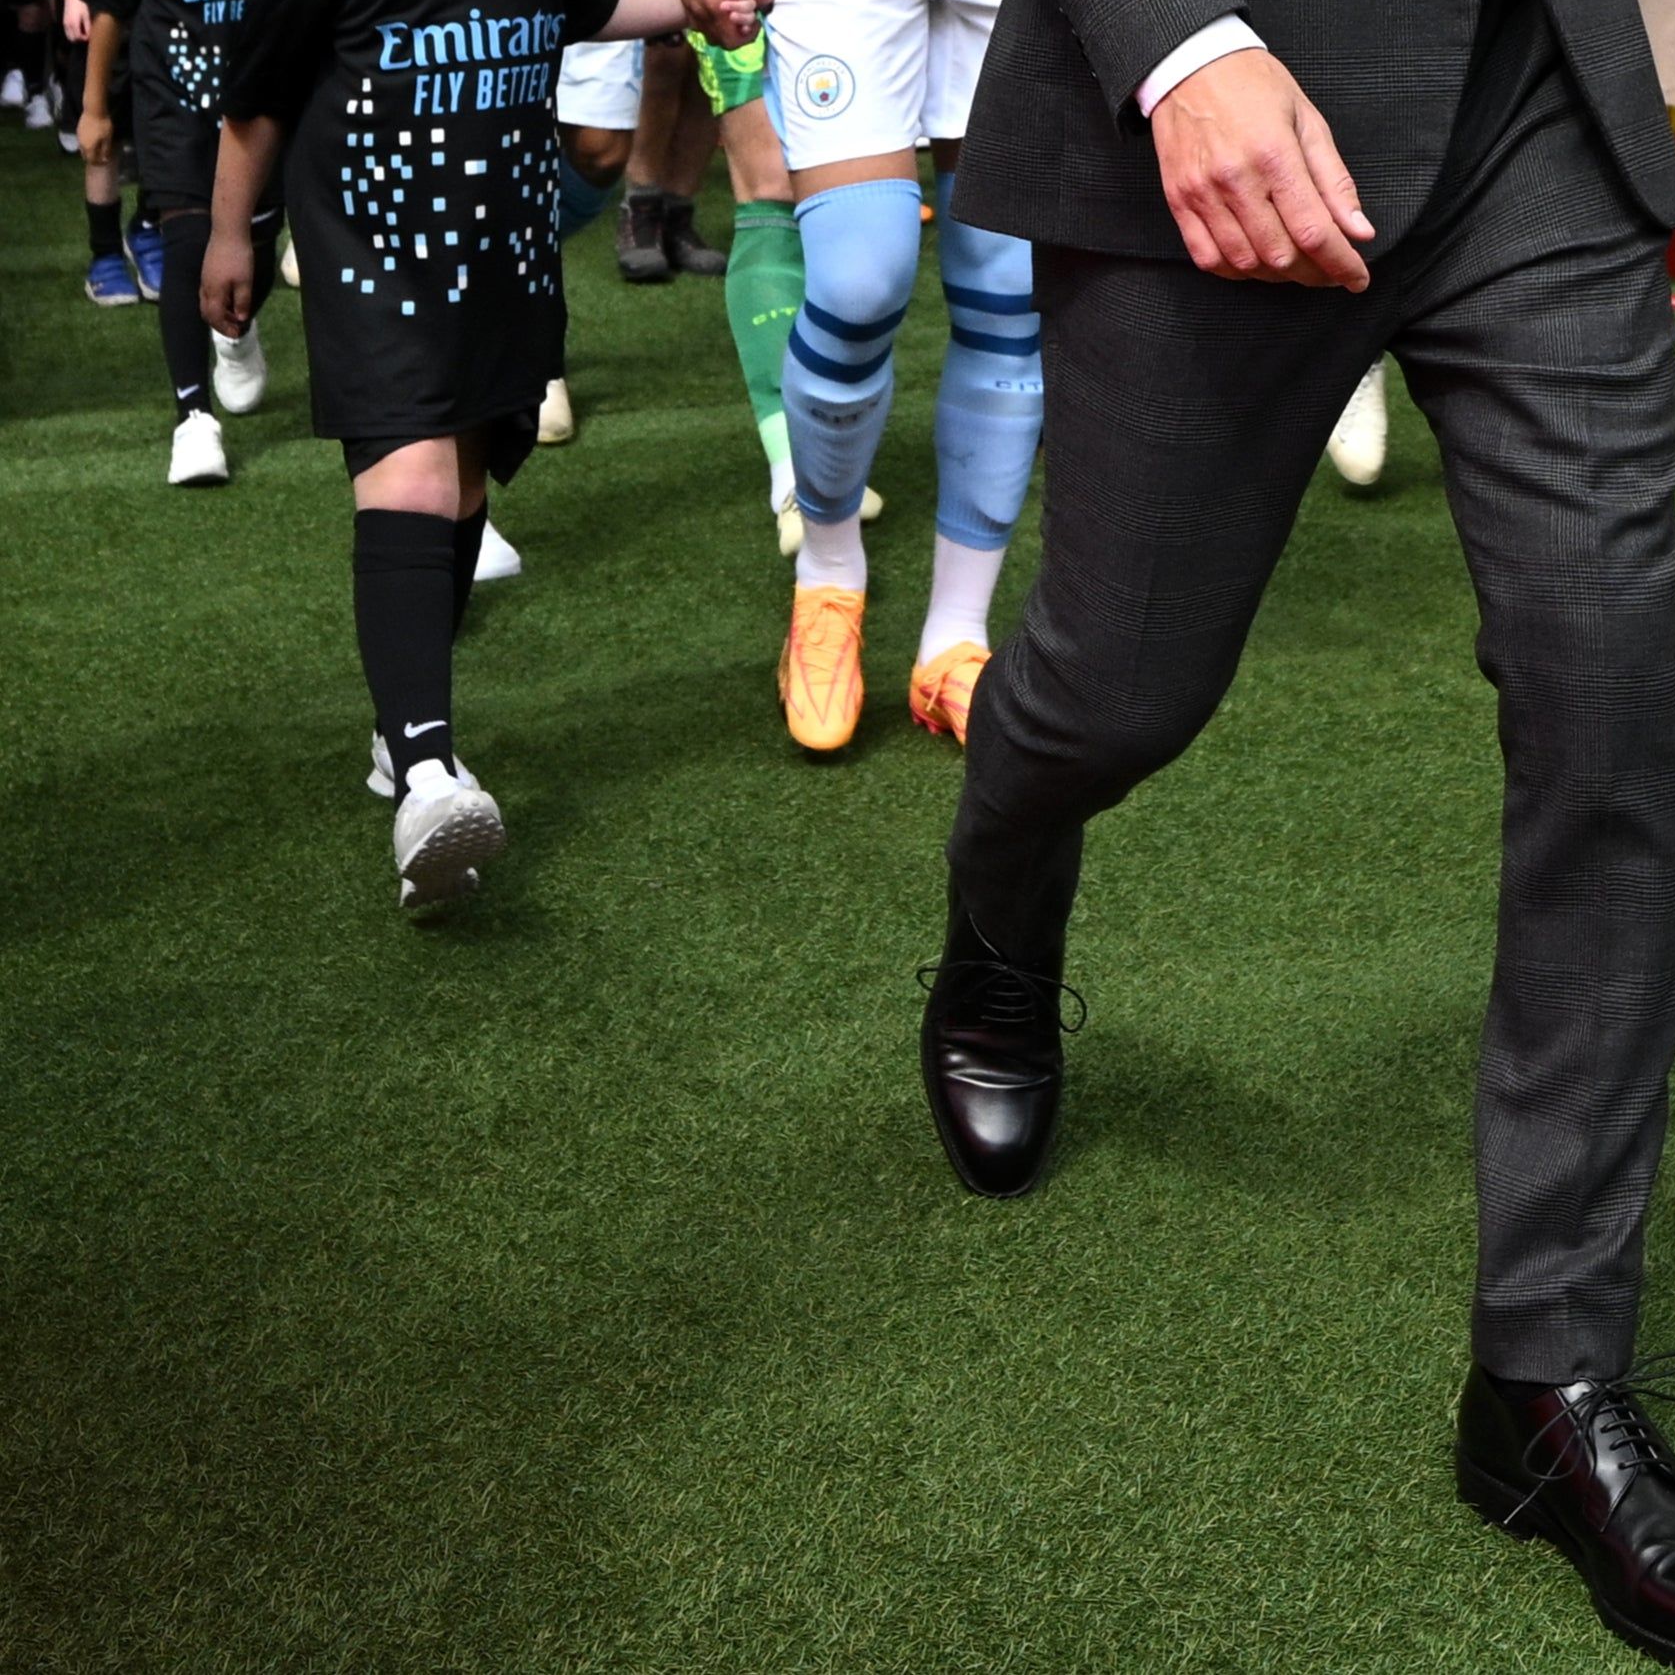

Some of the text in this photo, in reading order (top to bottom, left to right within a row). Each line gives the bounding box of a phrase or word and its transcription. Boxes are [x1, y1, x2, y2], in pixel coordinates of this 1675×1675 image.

[375, 8, 567, 71] Emirates
[412, 62, 549, 117] FLY BETTER
[995, 380, 1041, 393] CIT
